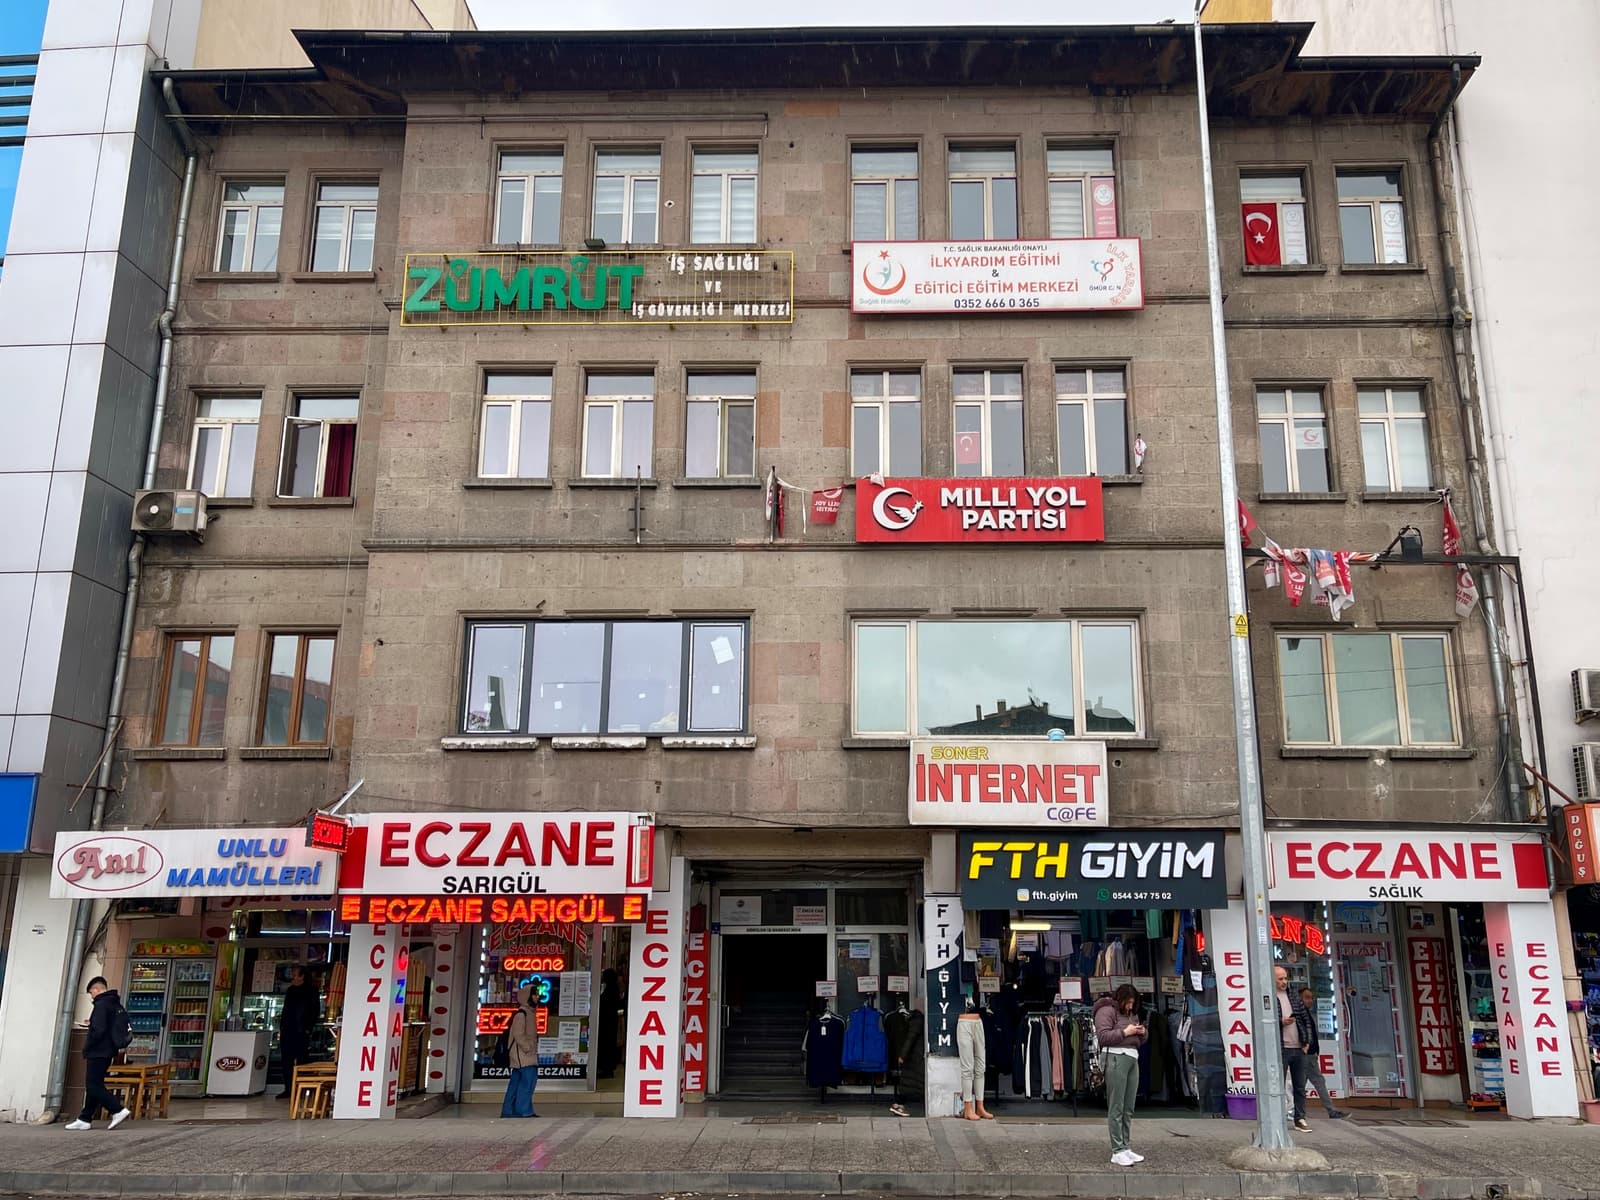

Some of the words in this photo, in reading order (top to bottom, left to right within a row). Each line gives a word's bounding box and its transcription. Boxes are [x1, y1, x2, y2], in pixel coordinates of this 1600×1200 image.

[670, 254, 686, 275] İŞ
[693, 253, 760, 271] SAĞLIĞI
[930, 254, 1005, 267] İLKYARDIM
[1009, 252, 1060, 266] EĞİTİMİ
[404, 254, 644, 312] ZÜMRÜT
[991, 269, 999, 277] &
[704, 280, 722, 293] VE
[914, 282, 962, 294] EĞİTİCİ
[967, 280, 1014, 293] EĞİTİM
[1018, 278, 1078, 293] MERKEZİ
[632, 302, 645, 319] İŞ
[647, 302, 723, 317] GÜVENLİĞİ
[733, 302, 790, 316] MERKEZİ
[954, 298, 981, 308] 0352
[985, 298, 1005, 308] 666
[1009, 298, 1016, 308] 0
[1019, 298, 1039, 307] 365
[1025, 486, 1086, 507] YOL
[931, 746, 989, 760] SONER
[915, 754, 1100, 803] İNTERNET
[1047, 807, 1096, 822] C@FE
[217, 838, 288, 857] UNLU
[380, 821, 615, 867] ECZANE
[1570, 815, 1586, 877] DOĞUŞ
[968, 842, 1069, 879] FTH
[1286, 842, 1502, 880] ECZANE
[166, 861, 322, 887] MAMÜLLERİ
[442, 872, 546, 893] SARIGÜL
[1032, 890, 1078, 901] fth.giyim
[1113, 892, 1132, 900] 0544
[1134, 892, 1148, 900] 347
[1150, 892, 1160, 900] 75
[1161, 892, 1172, 900] 02
[1369, 884, 1423, 899] SAĞLIK
[369, 896, 483, 923] ECZANE
[491, 895, 615, 922] SARIGÜL
[509, 942, 565, 954] SARIGÜL
[504, 958, 564, 971] eczane
[638, 910, 669, 1106] ECZANE
[684, 932, 704, 1089] ECZANE
[1224, 952, 1253, 1081] ECZANE
[1412, 941, 1443, 1071] ECZANE
[1496, 943, 1519, 1074] ECZANE
[1526, 943, 1562, 1076] ECZANE
[481, 1067, 513, 1076] ECZA
[537, 1067, 581, 1076] ECZANE
[1227, 1085, 1256, 1095] SAĞLI
